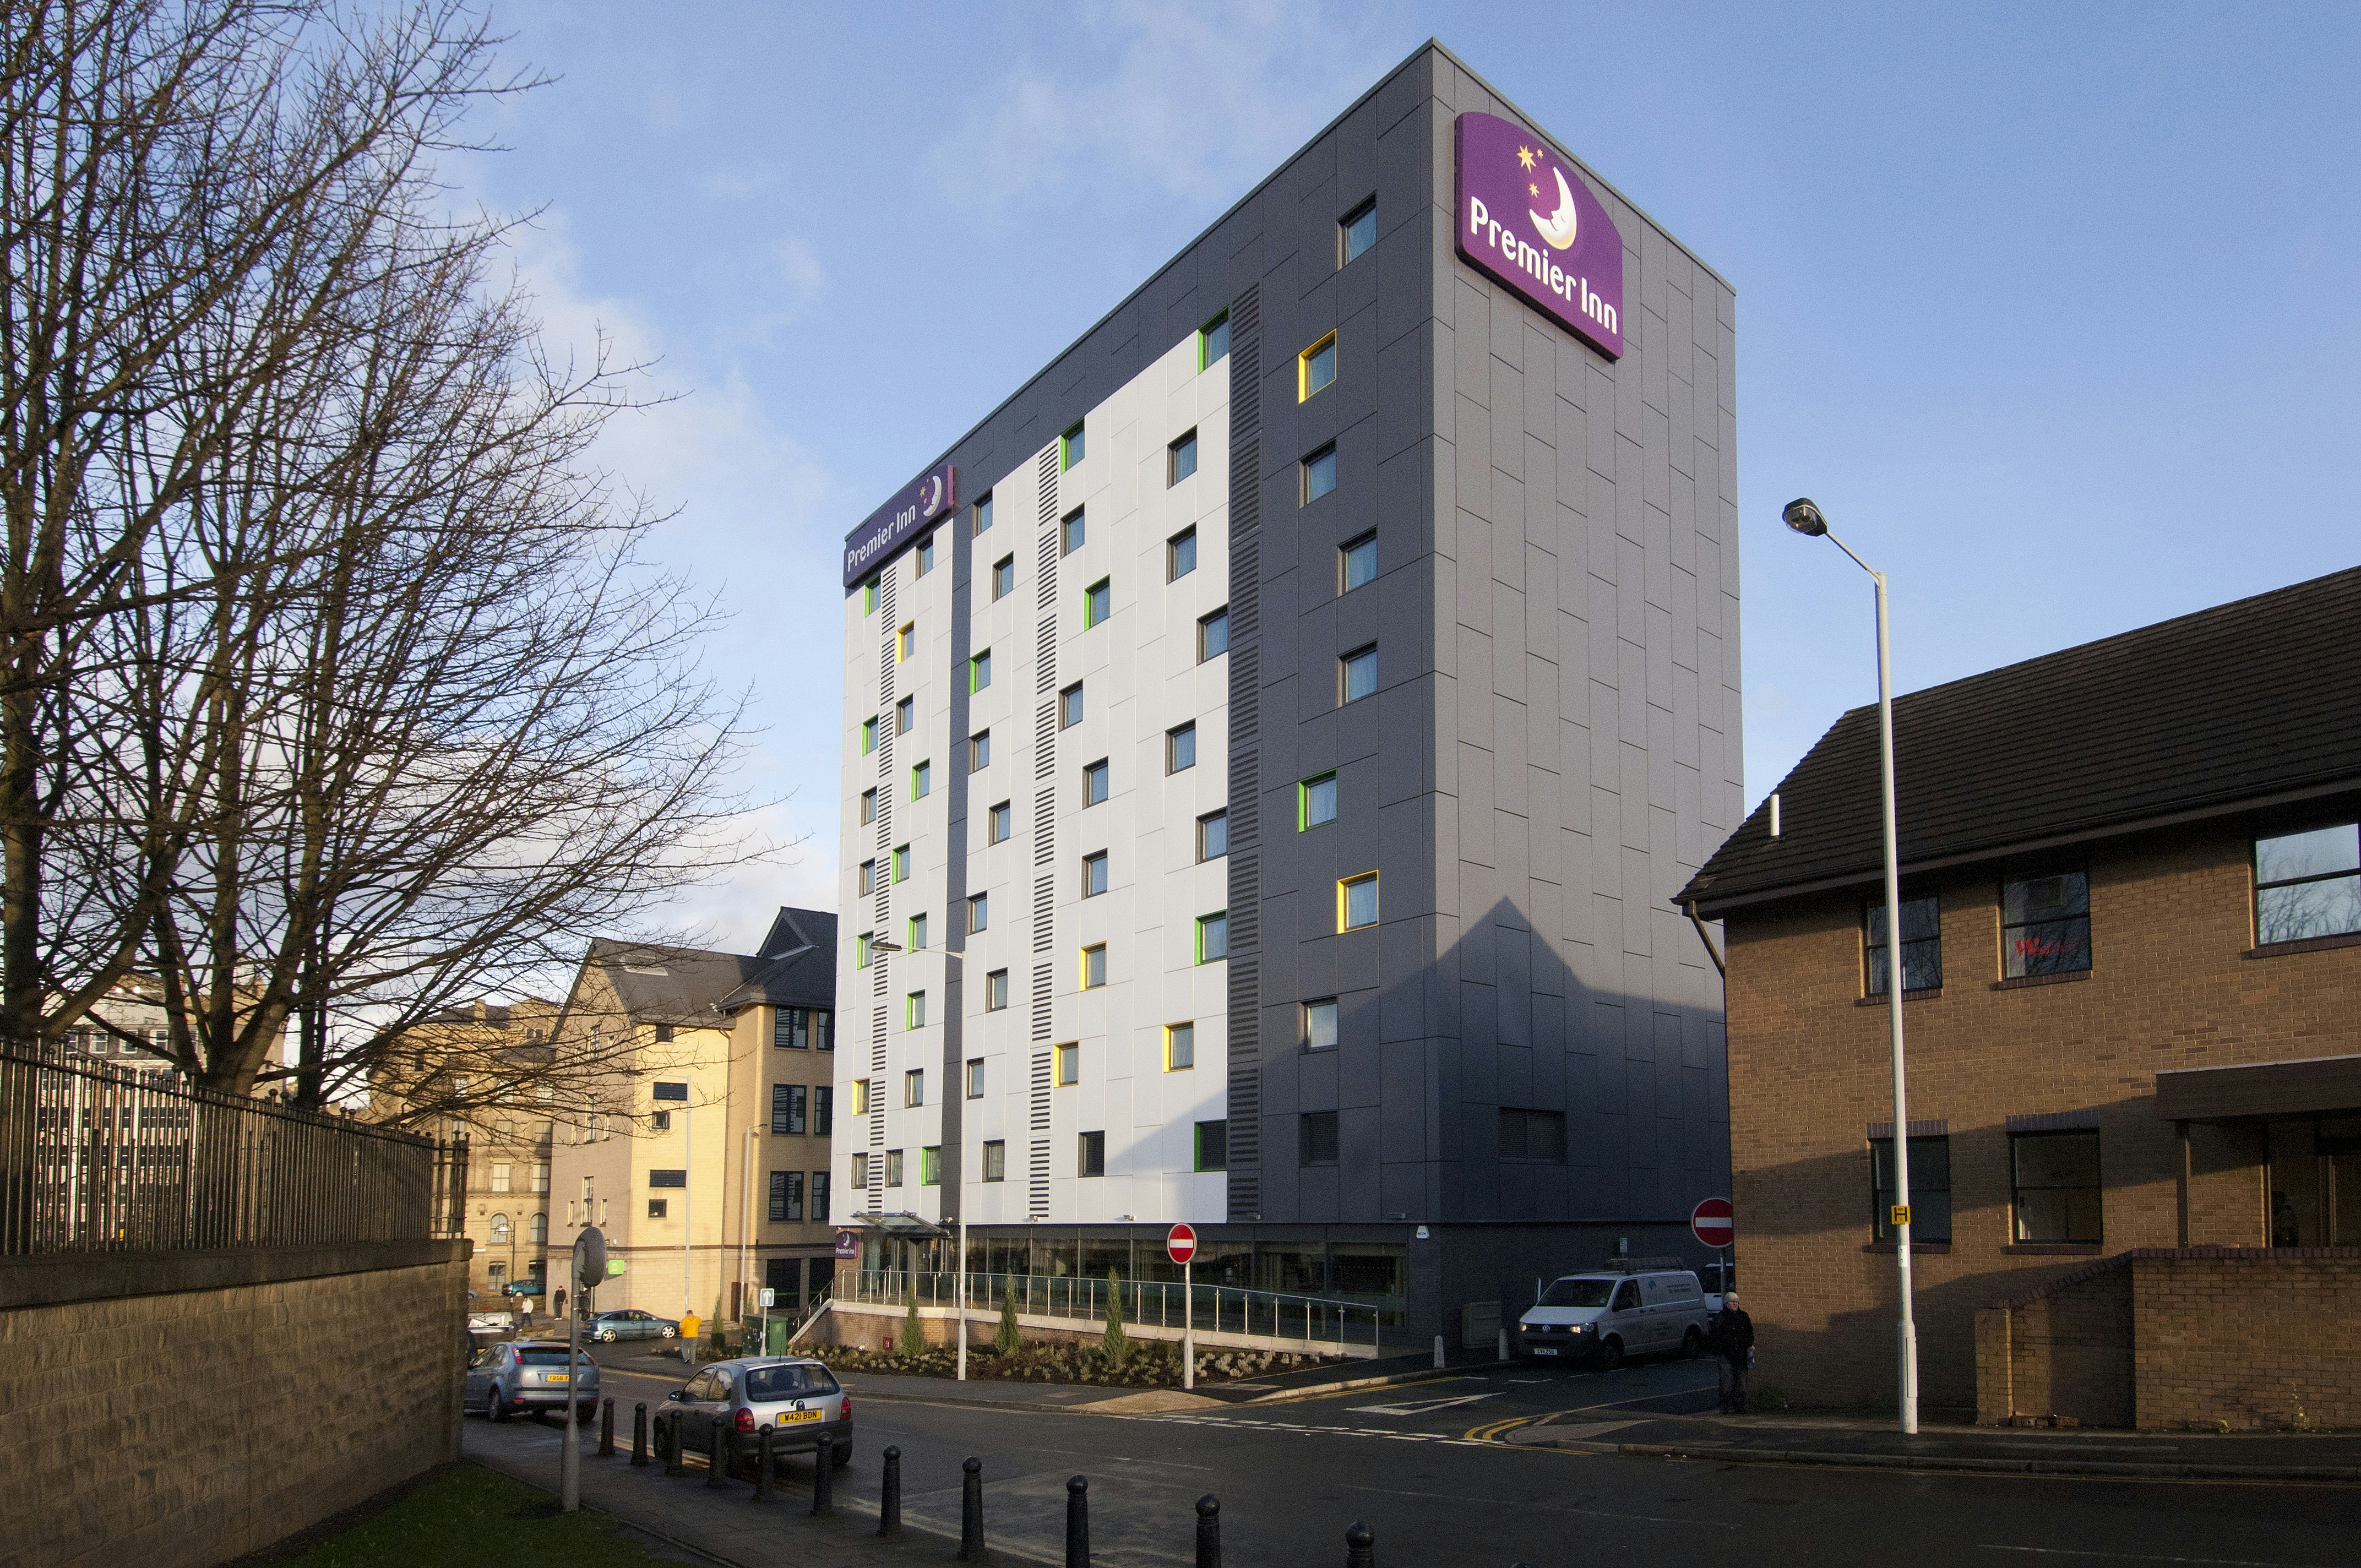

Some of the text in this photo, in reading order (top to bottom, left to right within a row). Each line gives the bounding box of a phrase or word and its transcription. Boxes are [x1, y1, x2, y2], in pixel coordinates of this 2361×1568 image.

[1471, 196, 1617, 334] Premier Inn
[847, 505, 916, 572] Premier Inn
[1894, 1207, 1907, 1221] H
[785, 1411, 817, 1422] W421 BDN
